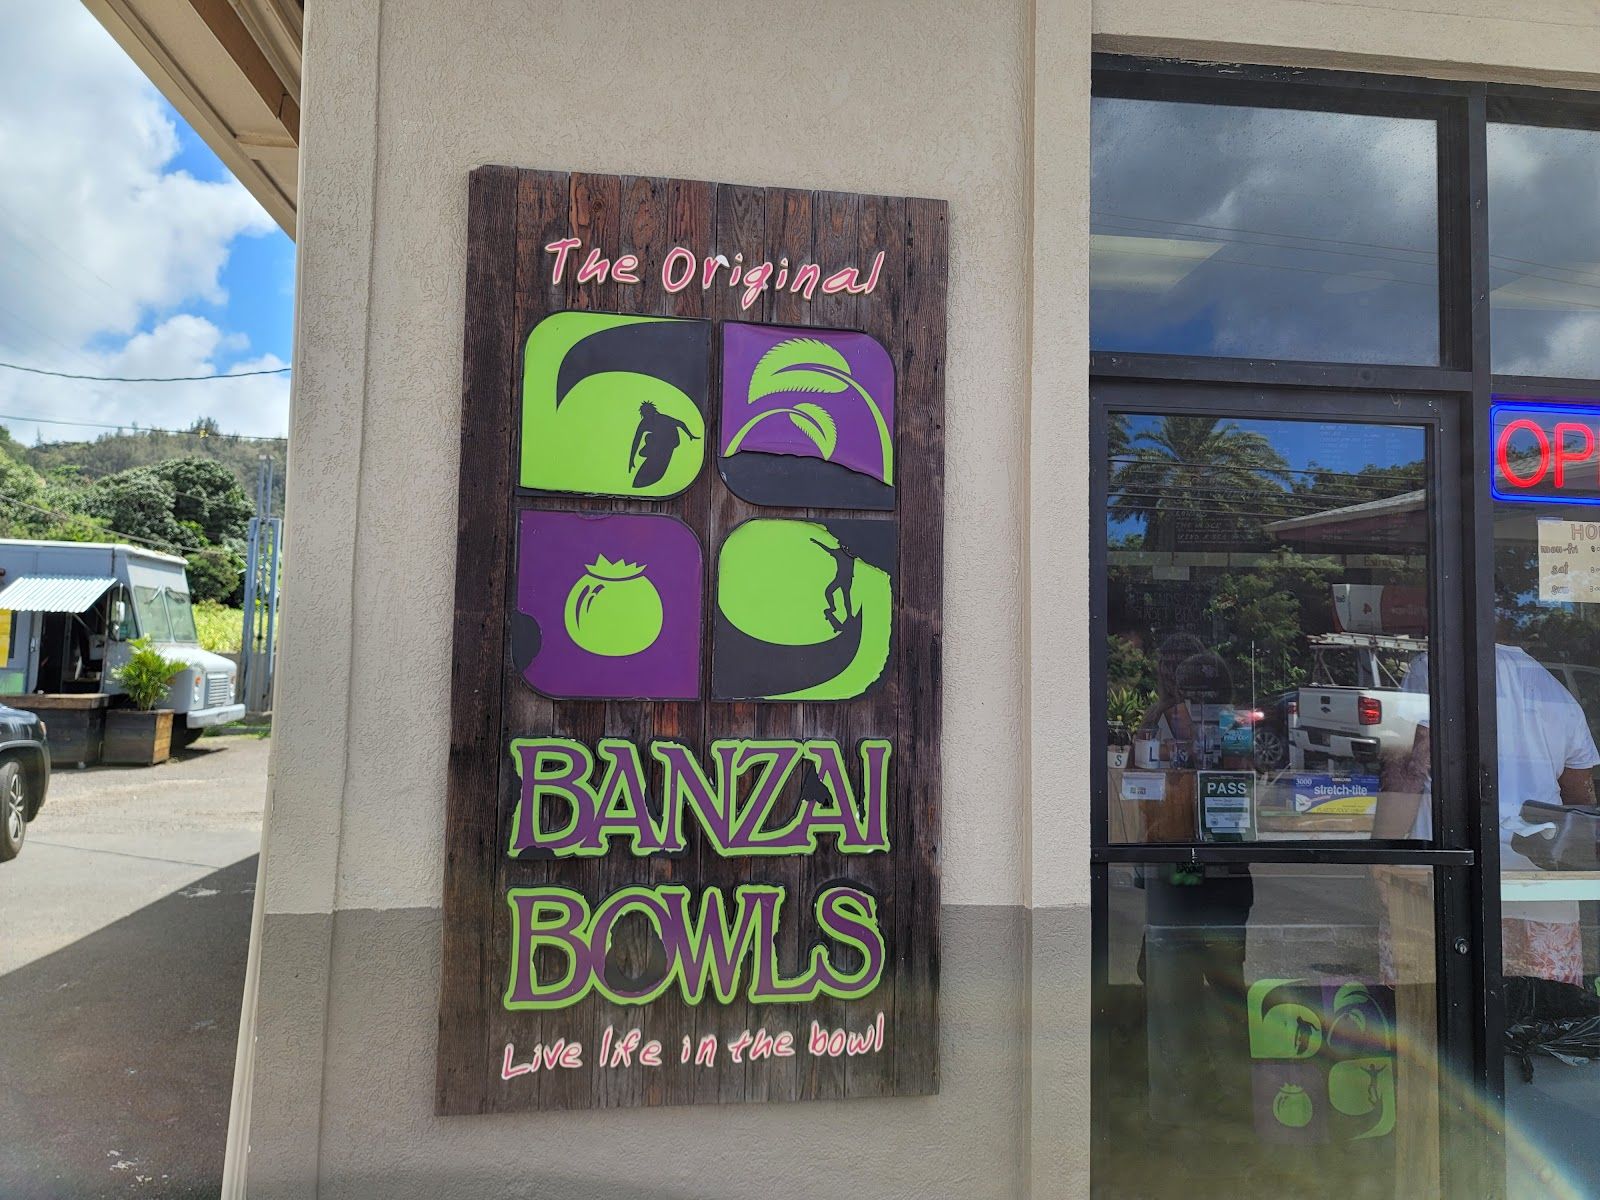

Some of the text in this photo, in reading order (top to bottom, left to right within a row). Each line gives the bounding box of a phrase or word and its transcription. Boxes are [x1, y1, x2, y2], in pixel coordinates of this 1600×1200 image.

[544, 237, 885, 310] The Original
[1498, 419, 1600, 489] OP
[1571, 523, 1600, 540] HO
[507, 738, 891, 857] BANZAI
[1207, 782, 1247, 795] PASS
[1314, 784, 1368, 796] stretch-tite
[503, 884, 886, 1010] BOWLS
[500, 1011, 885, 1081] Live life in the bowl
